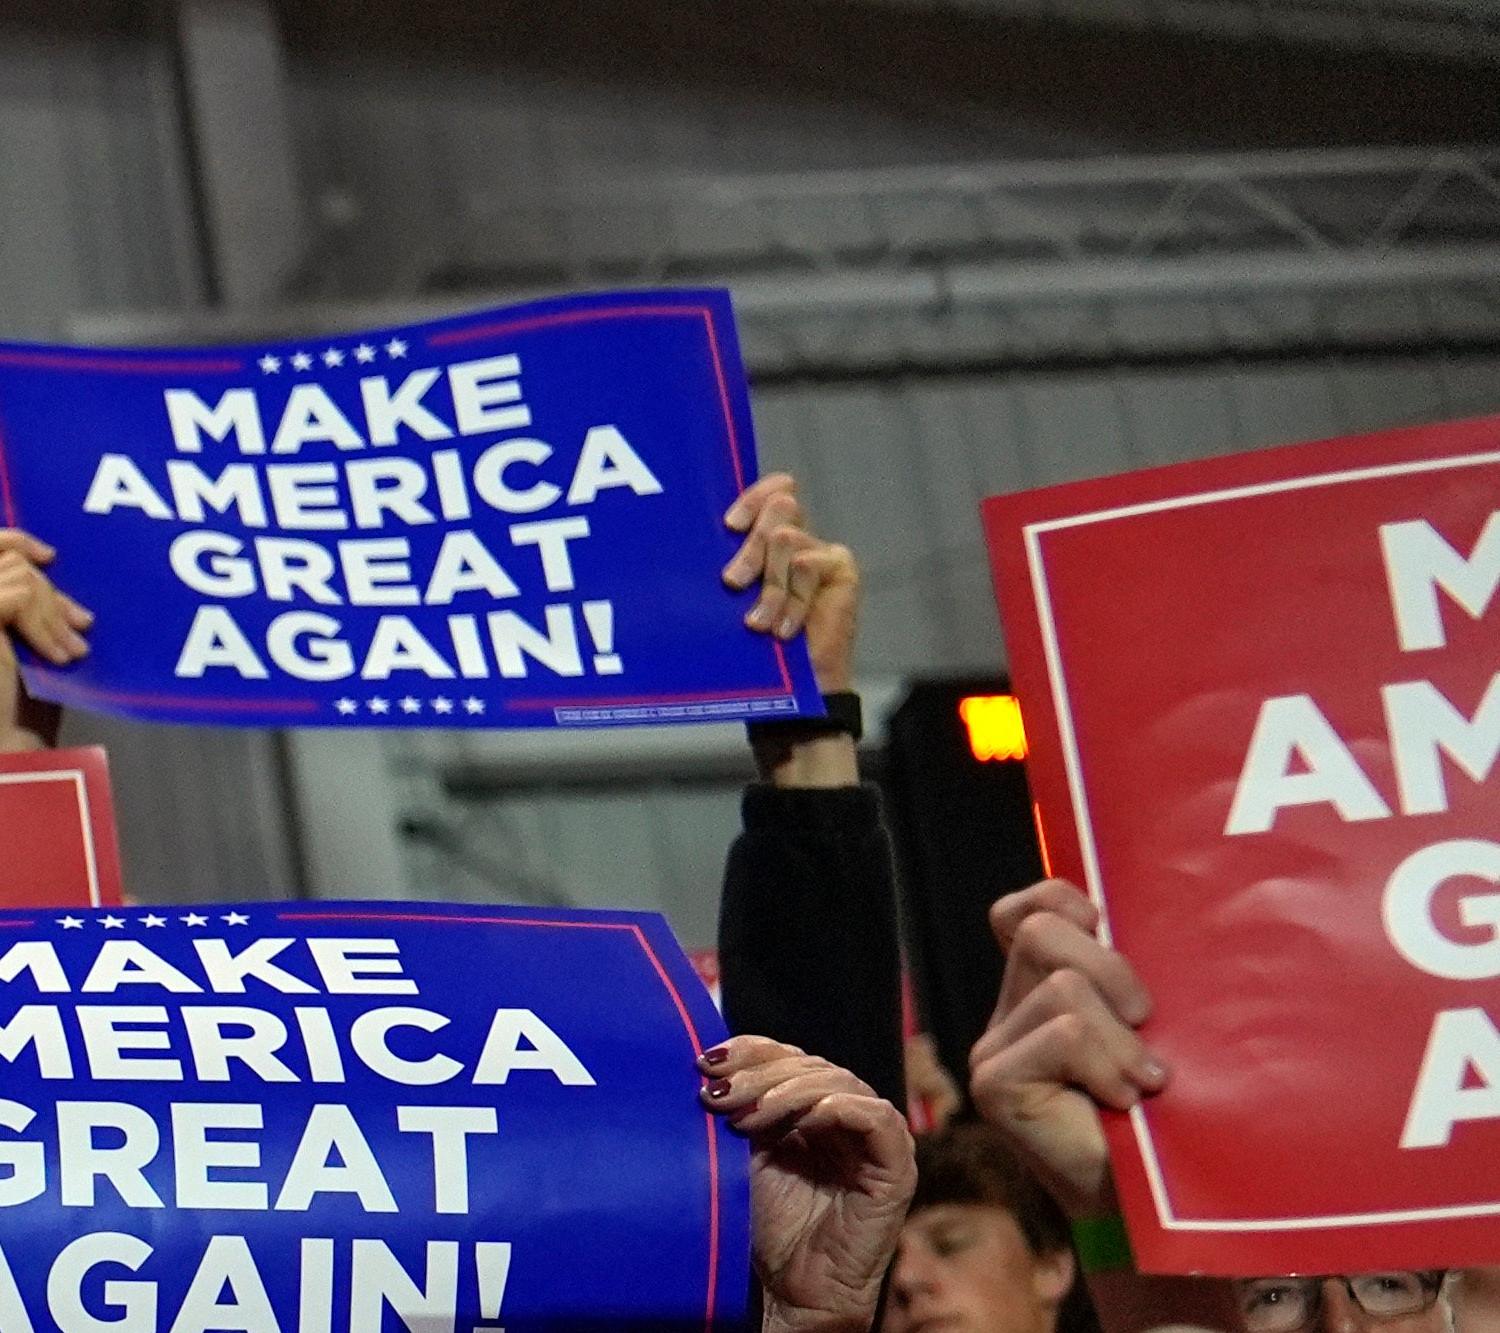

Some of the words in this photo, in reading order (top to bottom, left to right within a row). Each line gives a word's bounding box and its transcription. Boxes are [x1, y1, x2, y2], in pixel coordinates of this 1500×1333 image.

[163, 354, 533, 456] MAKE
[82, 424, 663, 530] AMERICA
[170, 516, 592, 605] GREAT
[173, 601, 623, 681] AGAIN!
